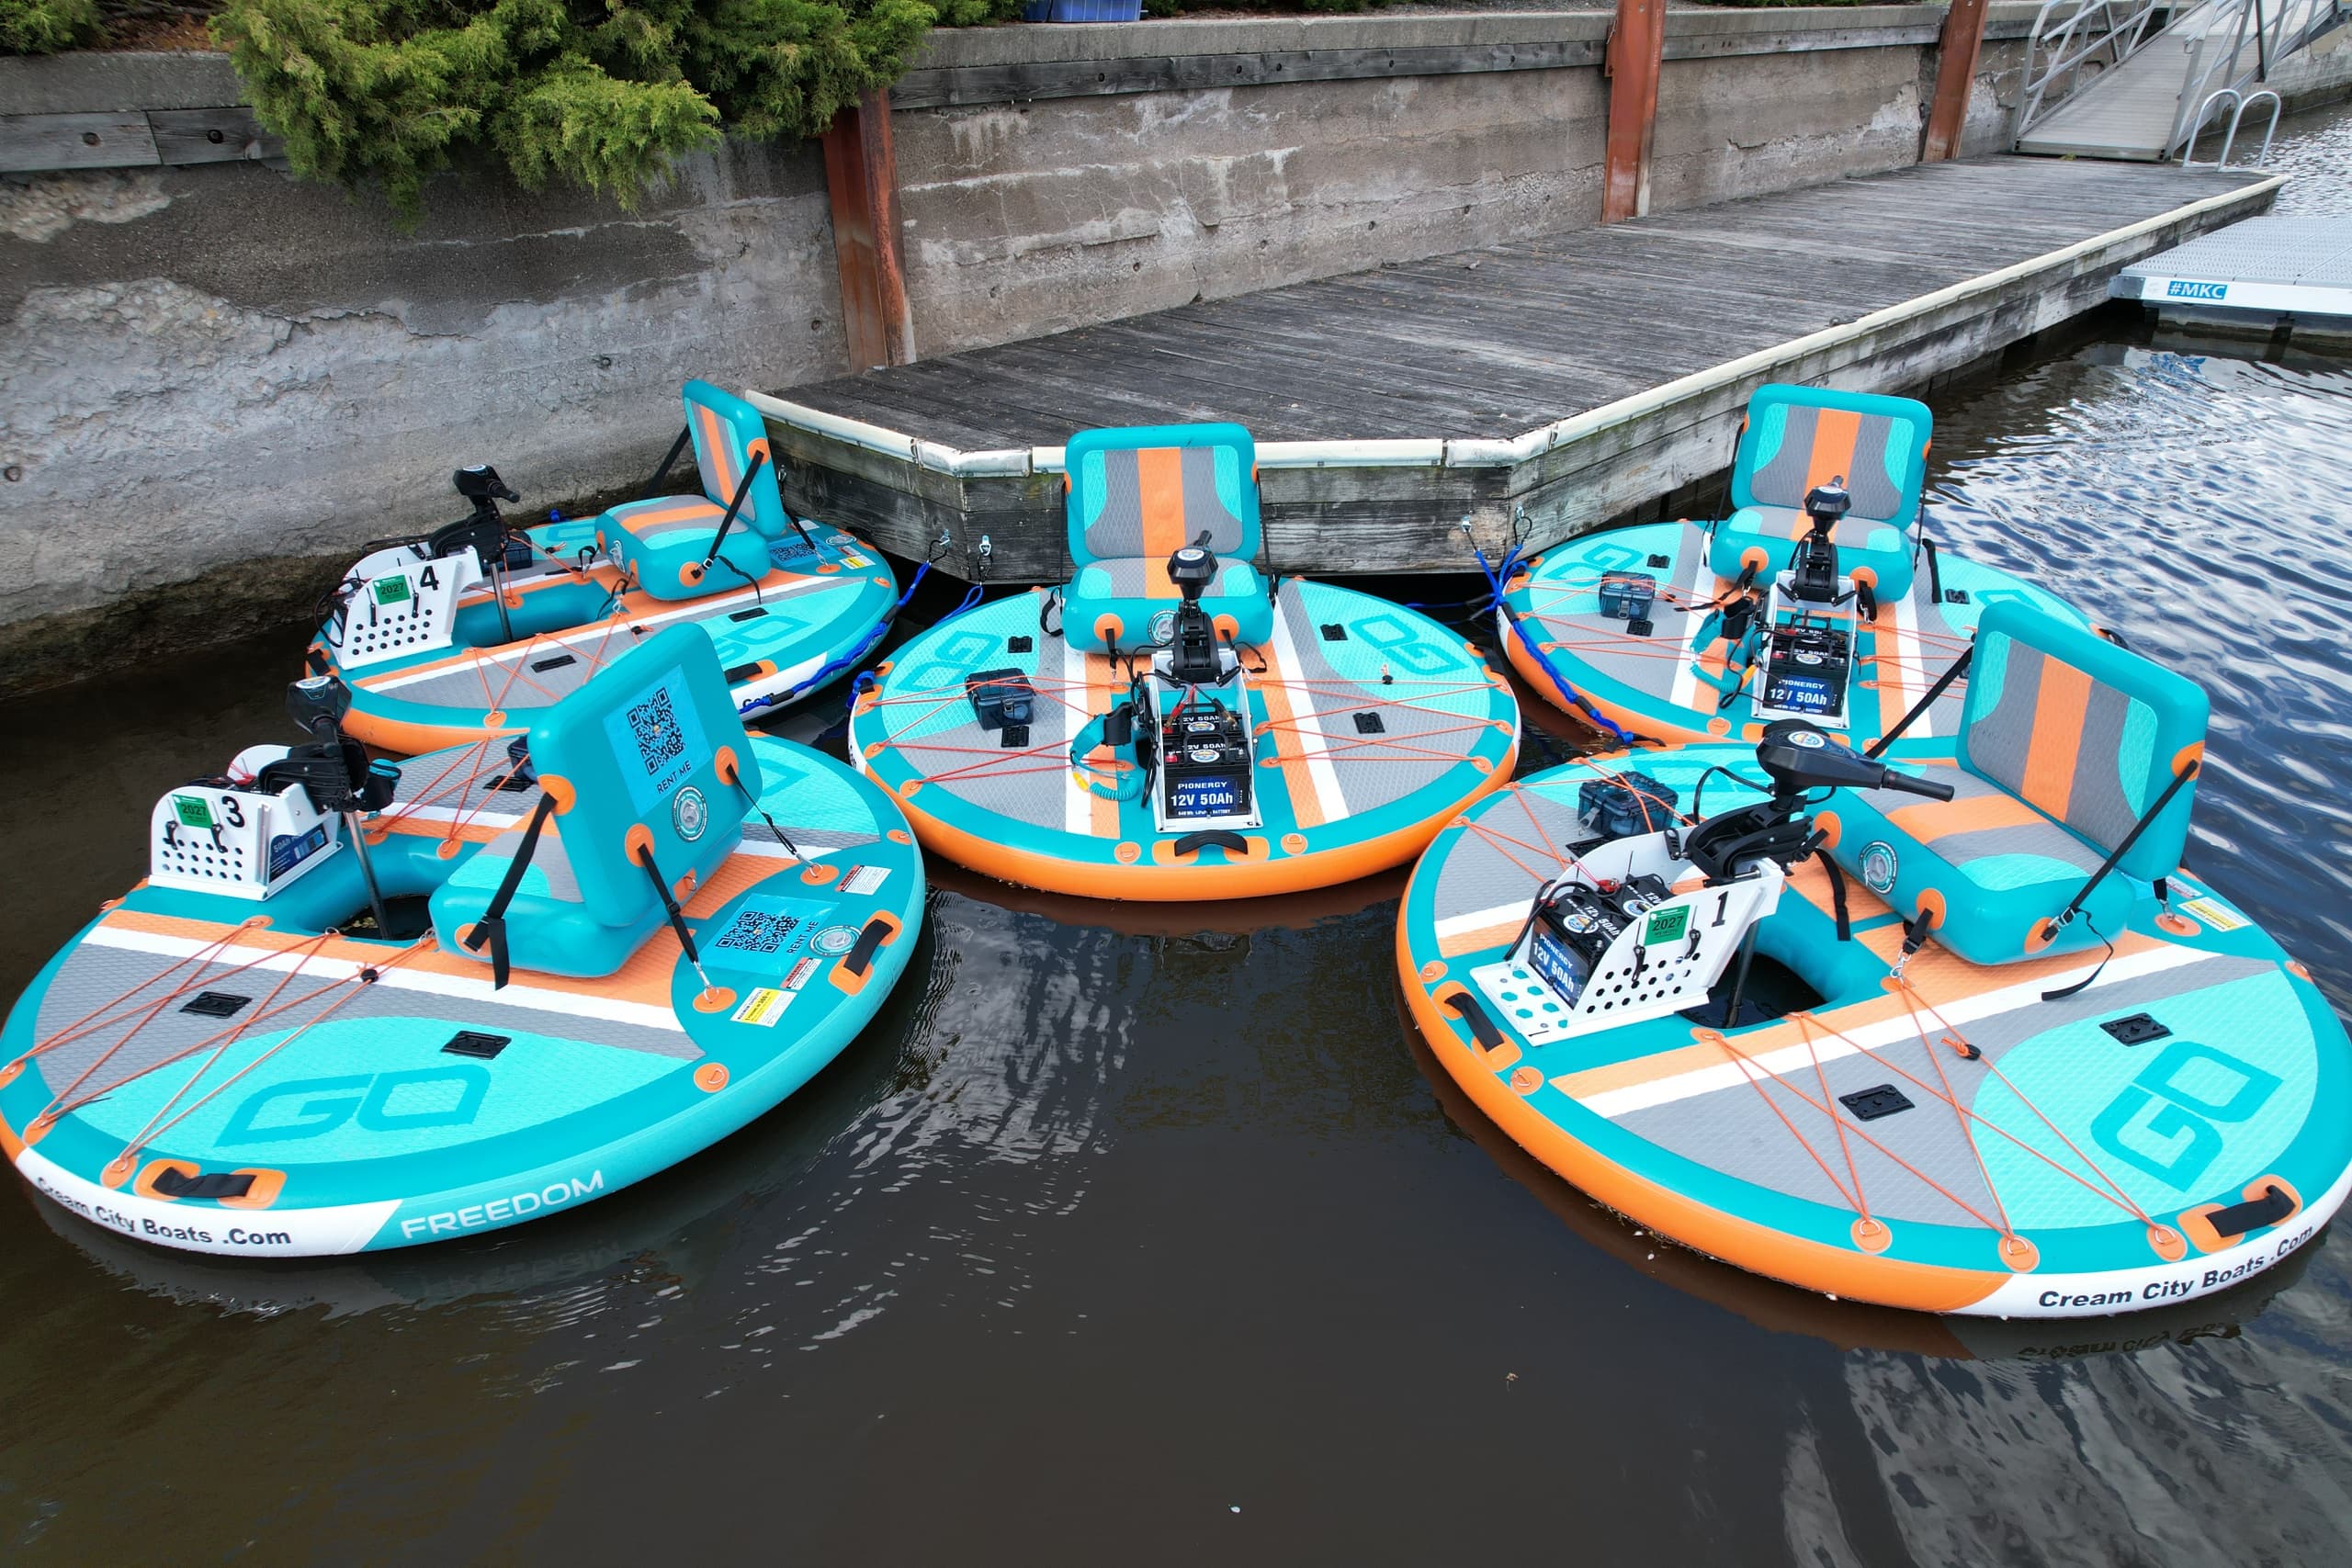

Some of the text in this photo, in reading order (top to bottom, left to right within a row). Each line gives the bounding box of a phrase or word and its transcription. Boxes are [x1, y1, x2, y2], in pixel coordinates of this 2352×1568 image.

[2169, 282, 2225, 299] #MKC
[380, 582, 404, 595] 2027
[419, 565, 440, 591] 4
[1349, 614, 1469, 675] GO
[1796, 692, 1827, 705] 50Ah
[657, 760, 692, 794] RENT ME
[1178, 781, 1227, 789] PIONERGY
[181, 804, 207, 817] 2027
[221, 795, 245, 828] 3
[1170, 794, 1195, 807] 12V
[1200, 793, 1233, 806] 50Ah
[1652, 916, 1684, 931] 2027
[1712, 891, 1729, 928] 1
[786, 933, 808, 954] RENT
[808, 920, 819, 933] ME
[1540, 932, 1573, 969] PIONERGY
[1533, 942, 1550, 966] 12V
[1552, 960, 1575, 993] 50Ah
[213, 1064, 492, 1148] GO
[2090, 1041, 2284, 1192] GO
[401, 1169, 605, 1239] FREEDOM
[96, 1205, 137, 1233] City
[142, 1218, 212, 1244] Boats
[221, 1228, 292, 1245] .Com
[2038, 1225, 2313, 1307] Cream City Boats .Com
